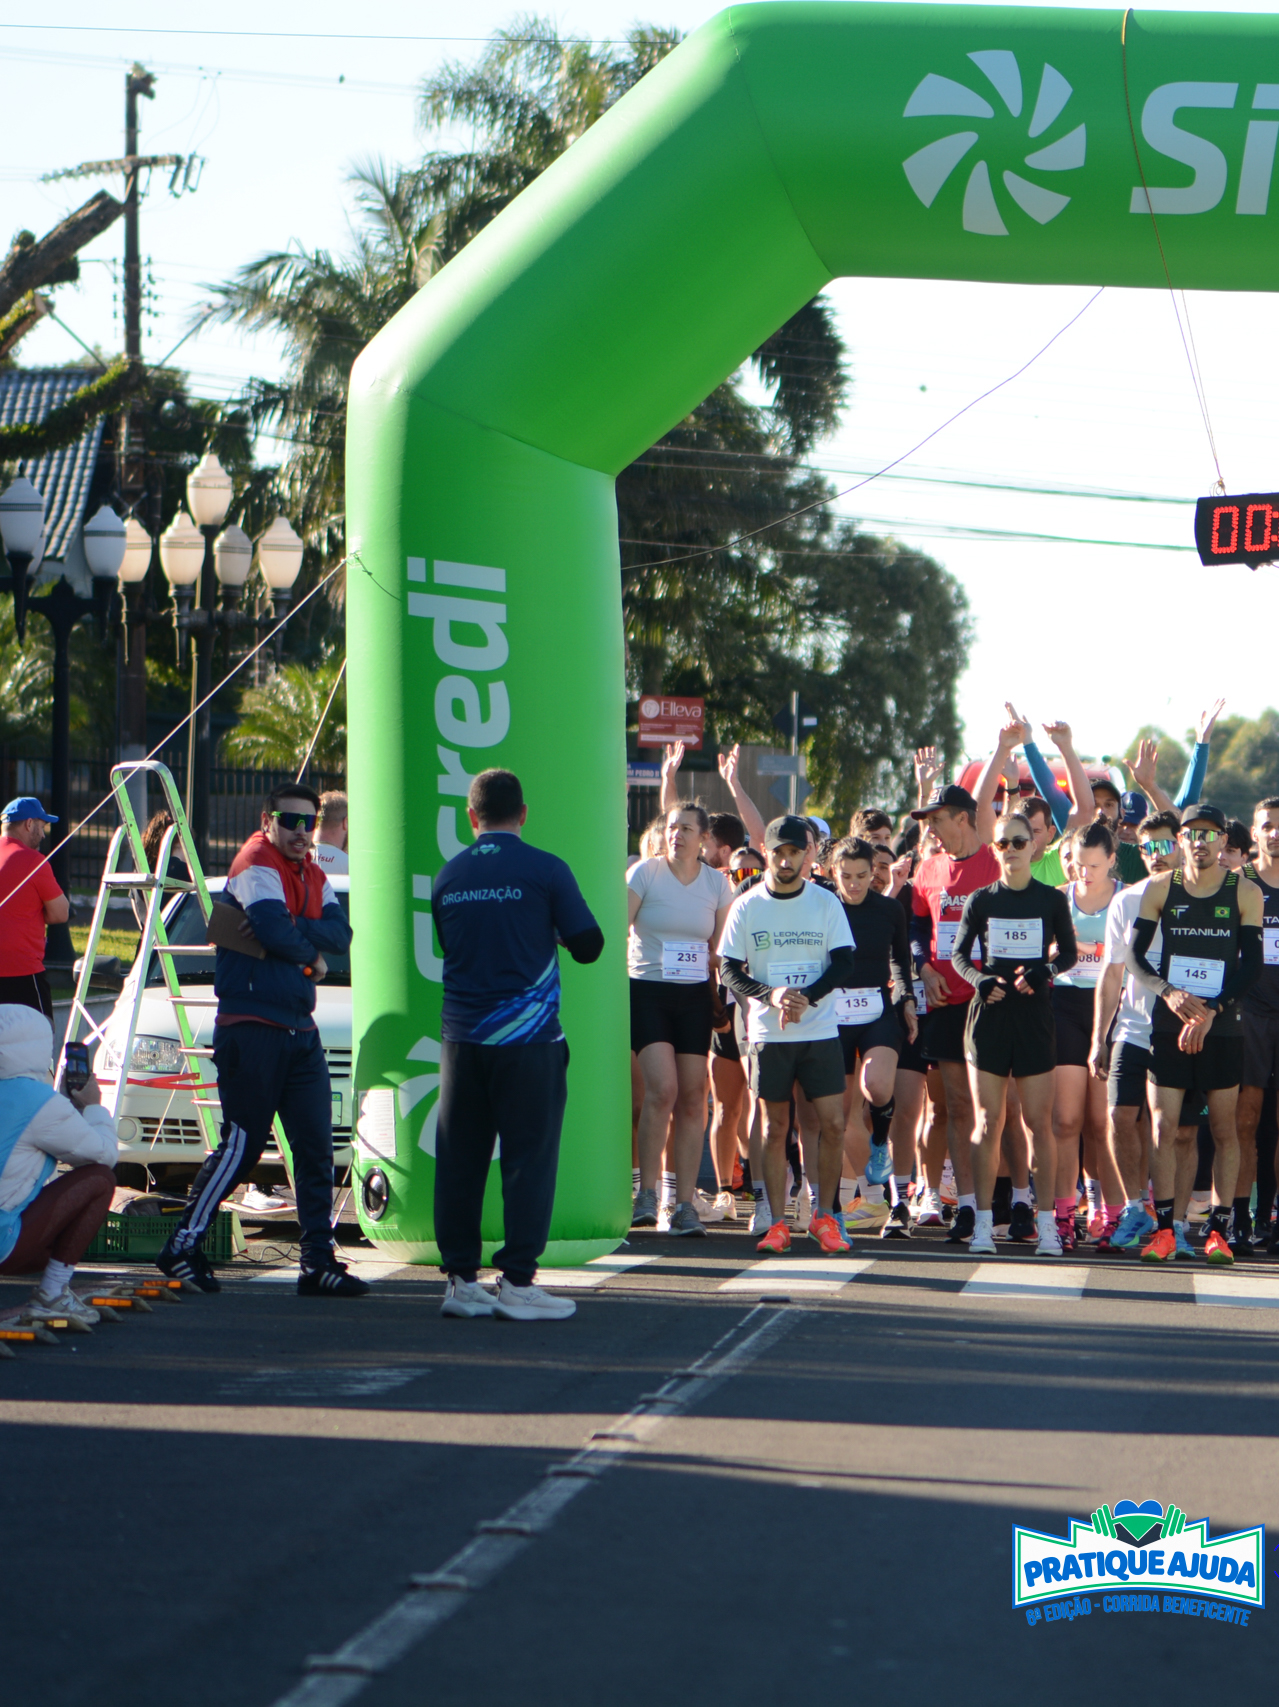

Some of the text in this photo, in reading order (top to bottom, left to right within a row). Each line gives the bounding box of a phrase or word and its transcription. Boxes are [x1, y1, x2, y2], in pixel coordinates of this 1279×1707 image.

[661, 701, 702, 718] Elleva
[442, 886, 522, 906] ORGANIZAÇÃO
[1004, 931, 1027, 940] 185
[1170, 927, 1231, 937] TITANIUM
[774, 939, 823, 948] BARBIERI
[677, 952, 698, 962] 235
[1184, 968, 1207, 979] 145
[785, 974, 807, 985] 177
[845, 998, 868, 1008] 135
